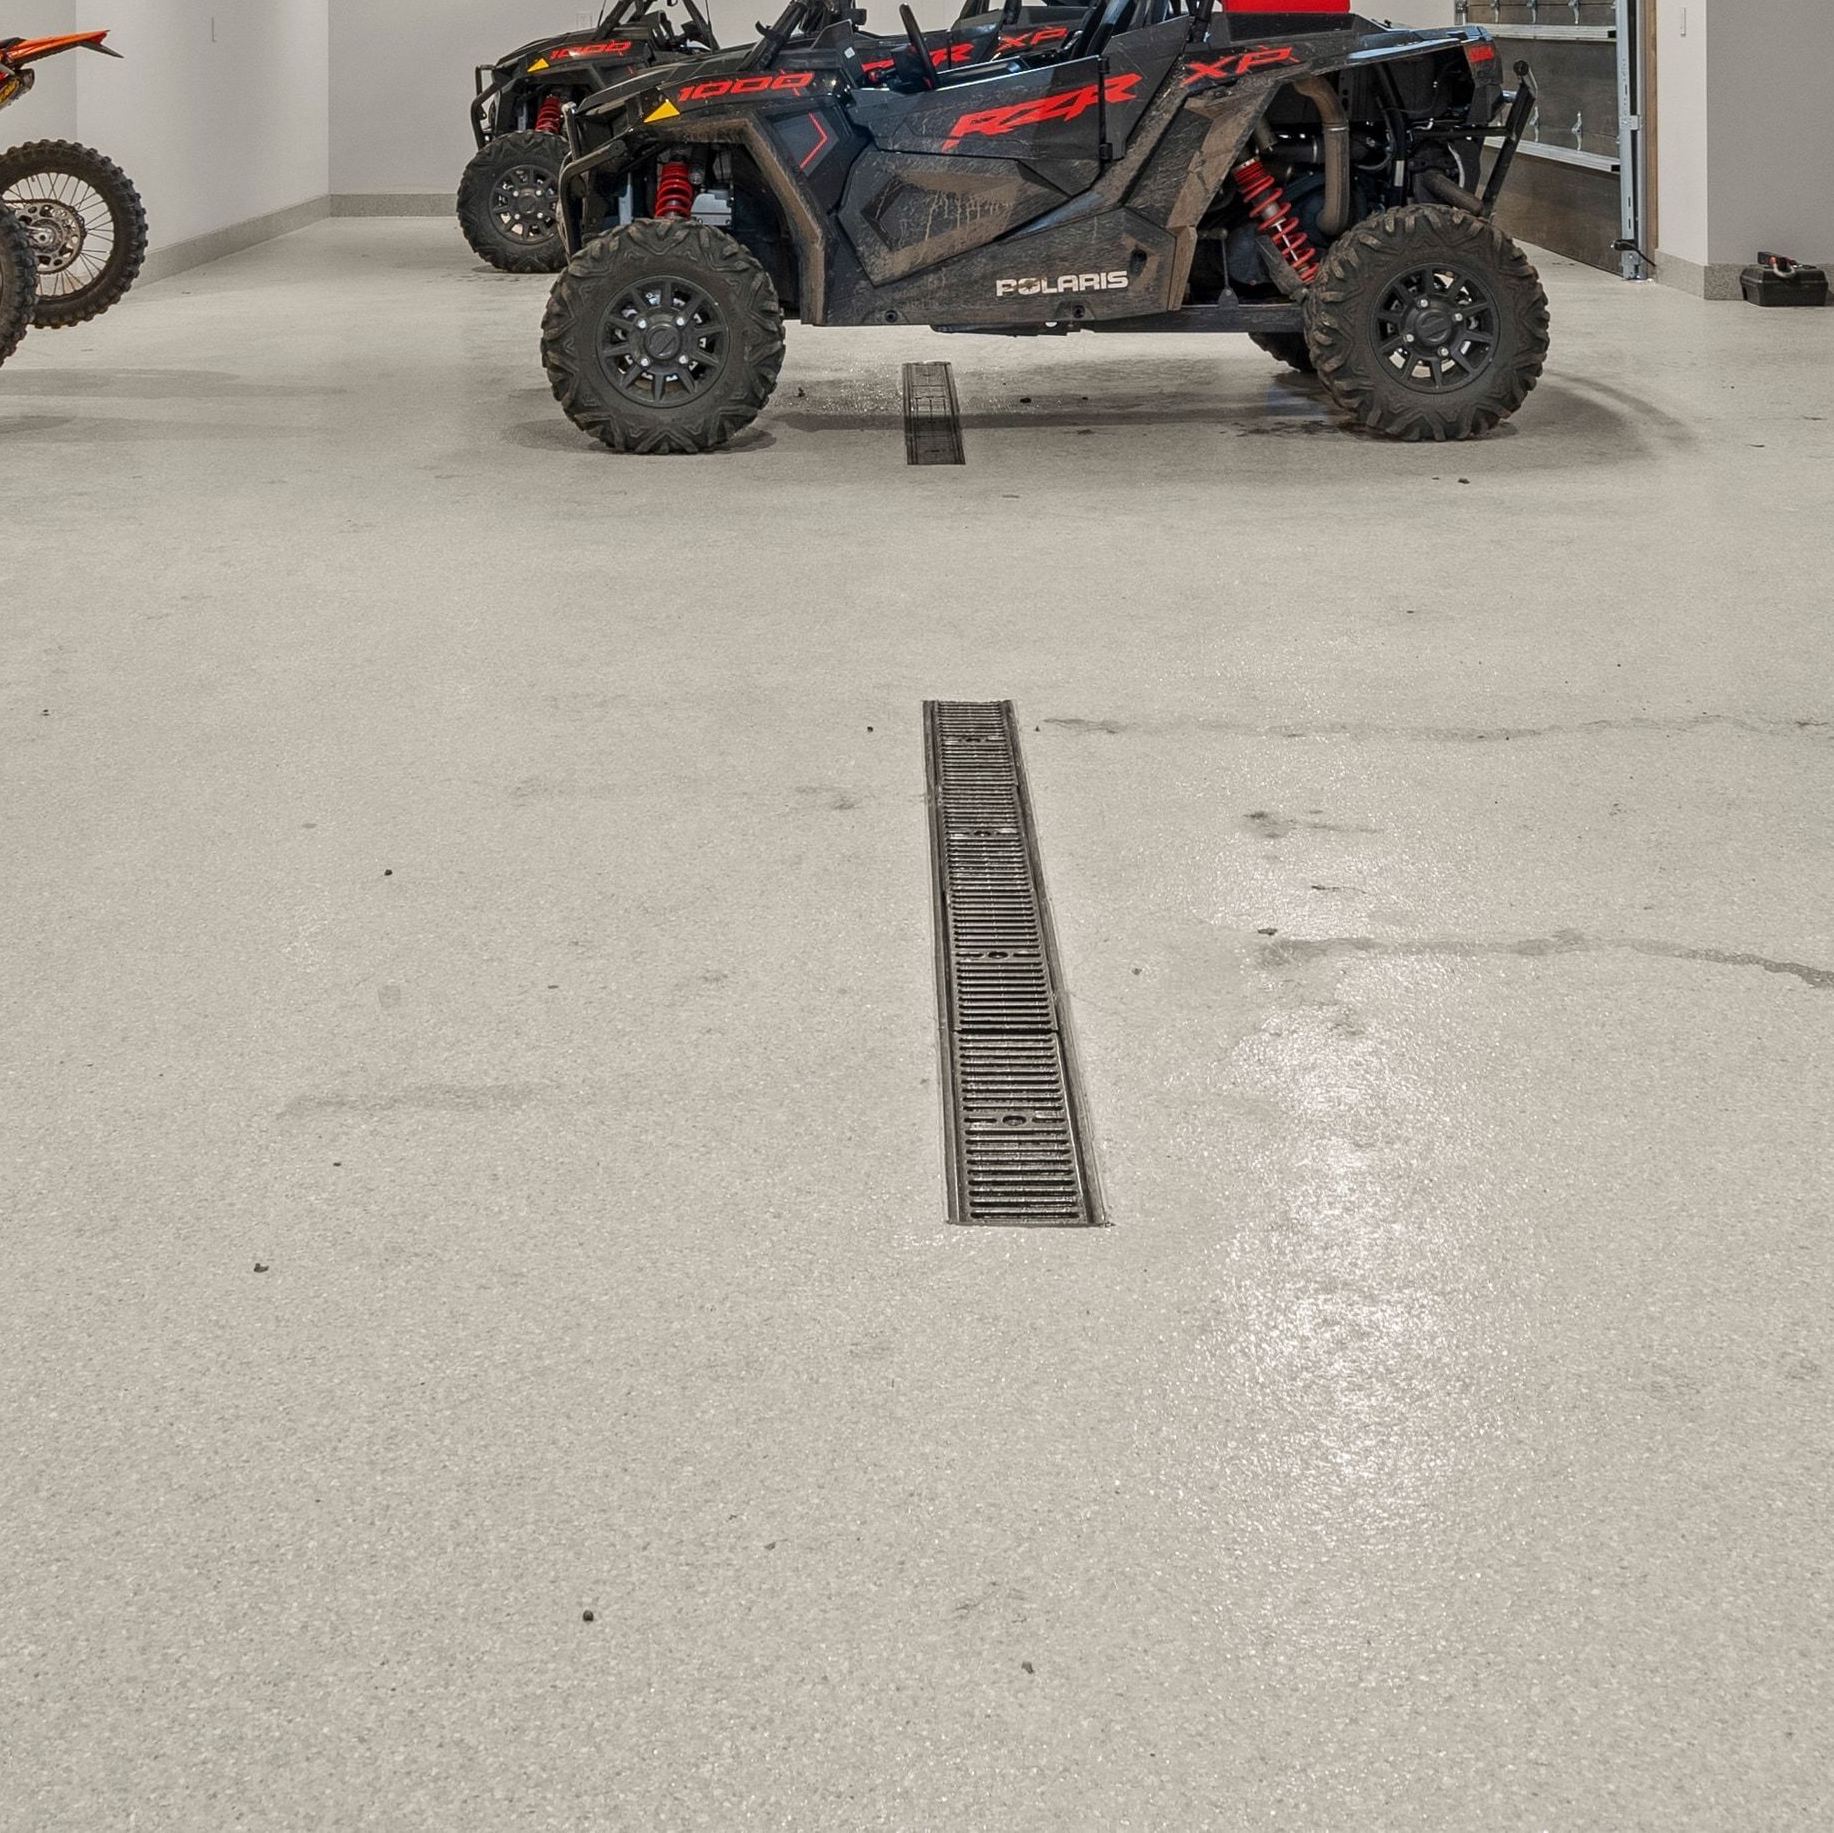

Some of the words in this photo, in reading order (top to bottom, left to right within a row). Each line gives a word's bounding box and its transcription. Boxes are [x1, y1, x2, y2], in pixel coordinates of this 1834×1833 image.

[549, 40, 632, 60] 1000
[997, 26, 1069, 51] XP
[1181, 45, 1295, 85] XP
[678, 71, 816, 102] 1000
[996, 270, 1129, 297] POLARIS
